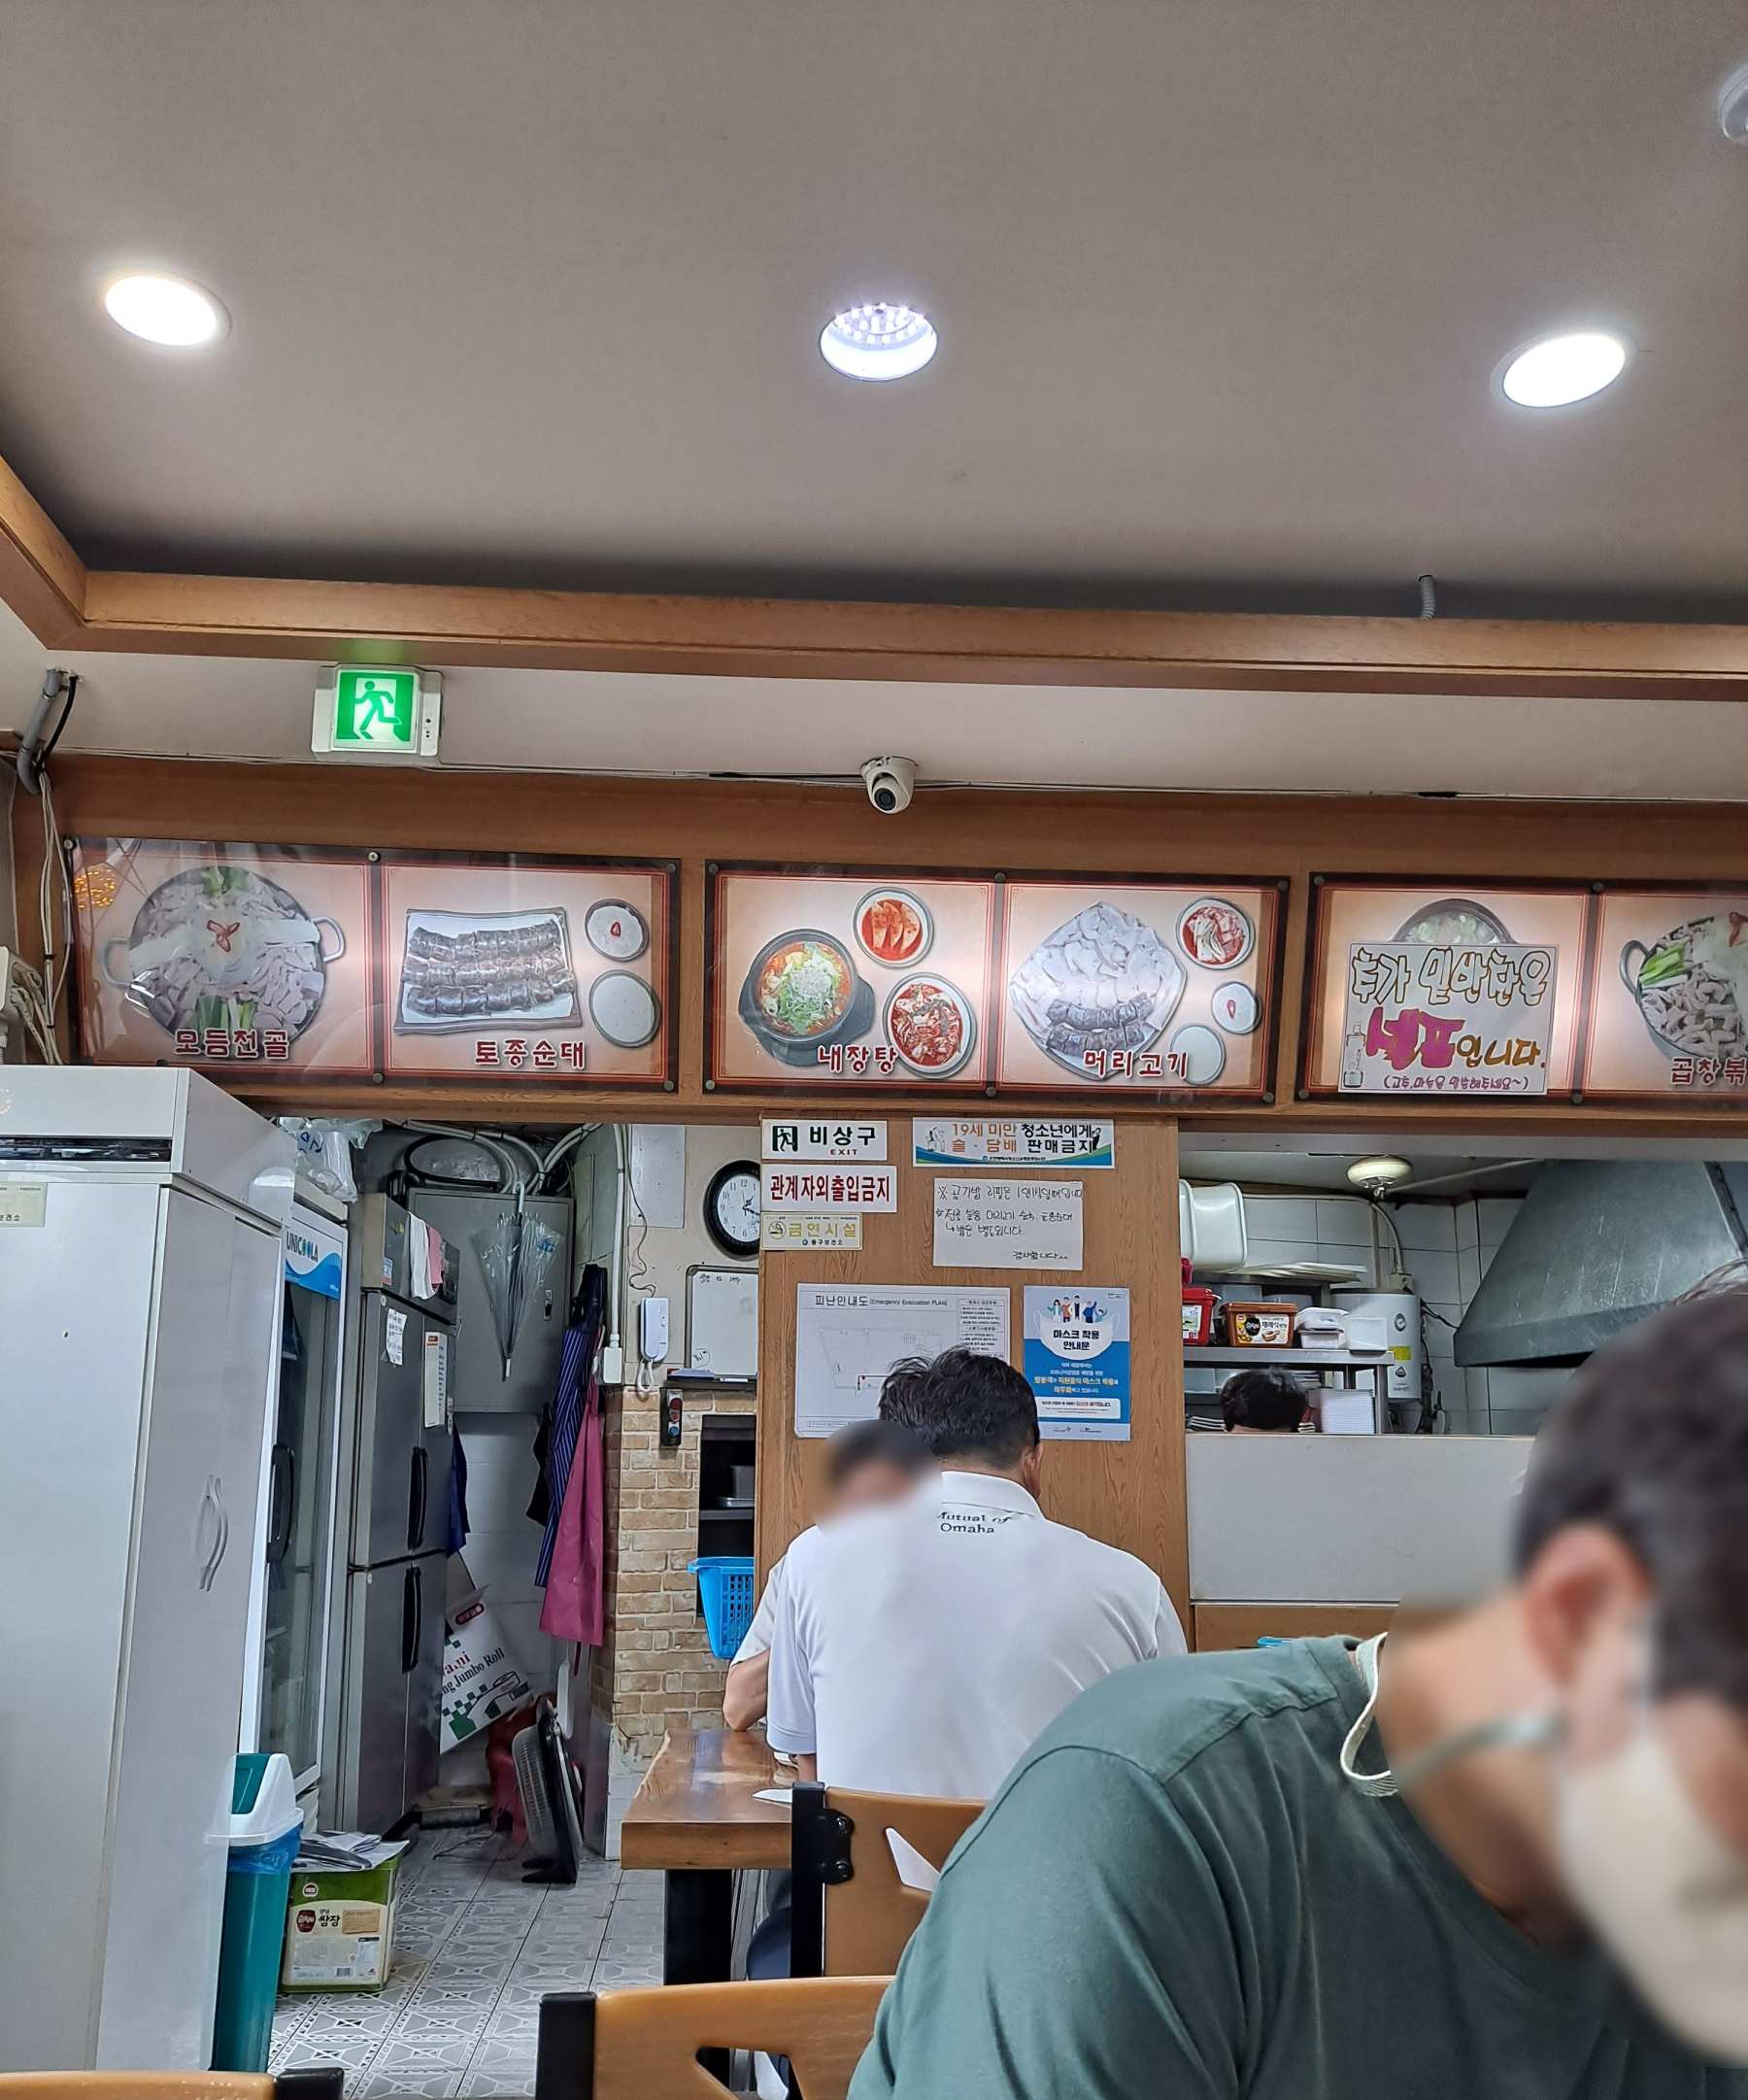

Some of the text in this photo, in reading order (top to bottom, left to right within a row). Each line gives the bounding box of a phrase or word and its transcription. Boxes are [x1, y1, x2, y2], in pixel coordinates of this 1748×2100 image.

[1352, 947, 1411, 1004] 추가
[175, 1029, 290, 1060] 모듬전골
[474, 1038, 586, 1069] 토종순대
[817, 1042, 899, 1074] 내장탕
[1084, 1050, 1189, 1078] 머리고기
[810, 1126, 876, 1146] 비상구
[952, 1123, 1093, 1138] 19세 미만 청소년에게
[952, 1139, 1093, 1154] 술 담배 판매금지
[789, 1223, 857, 1238] 금연시설
[1053, 1329, 1100, 1340] 마스크 착용
[1063, 1340, 1091, 1351] 안내문
[940, 1522, 995, 1534] Omaha
[454, 1662, 486, 1688] Jumbo
[483, 1646, 506, 1668] Roll
